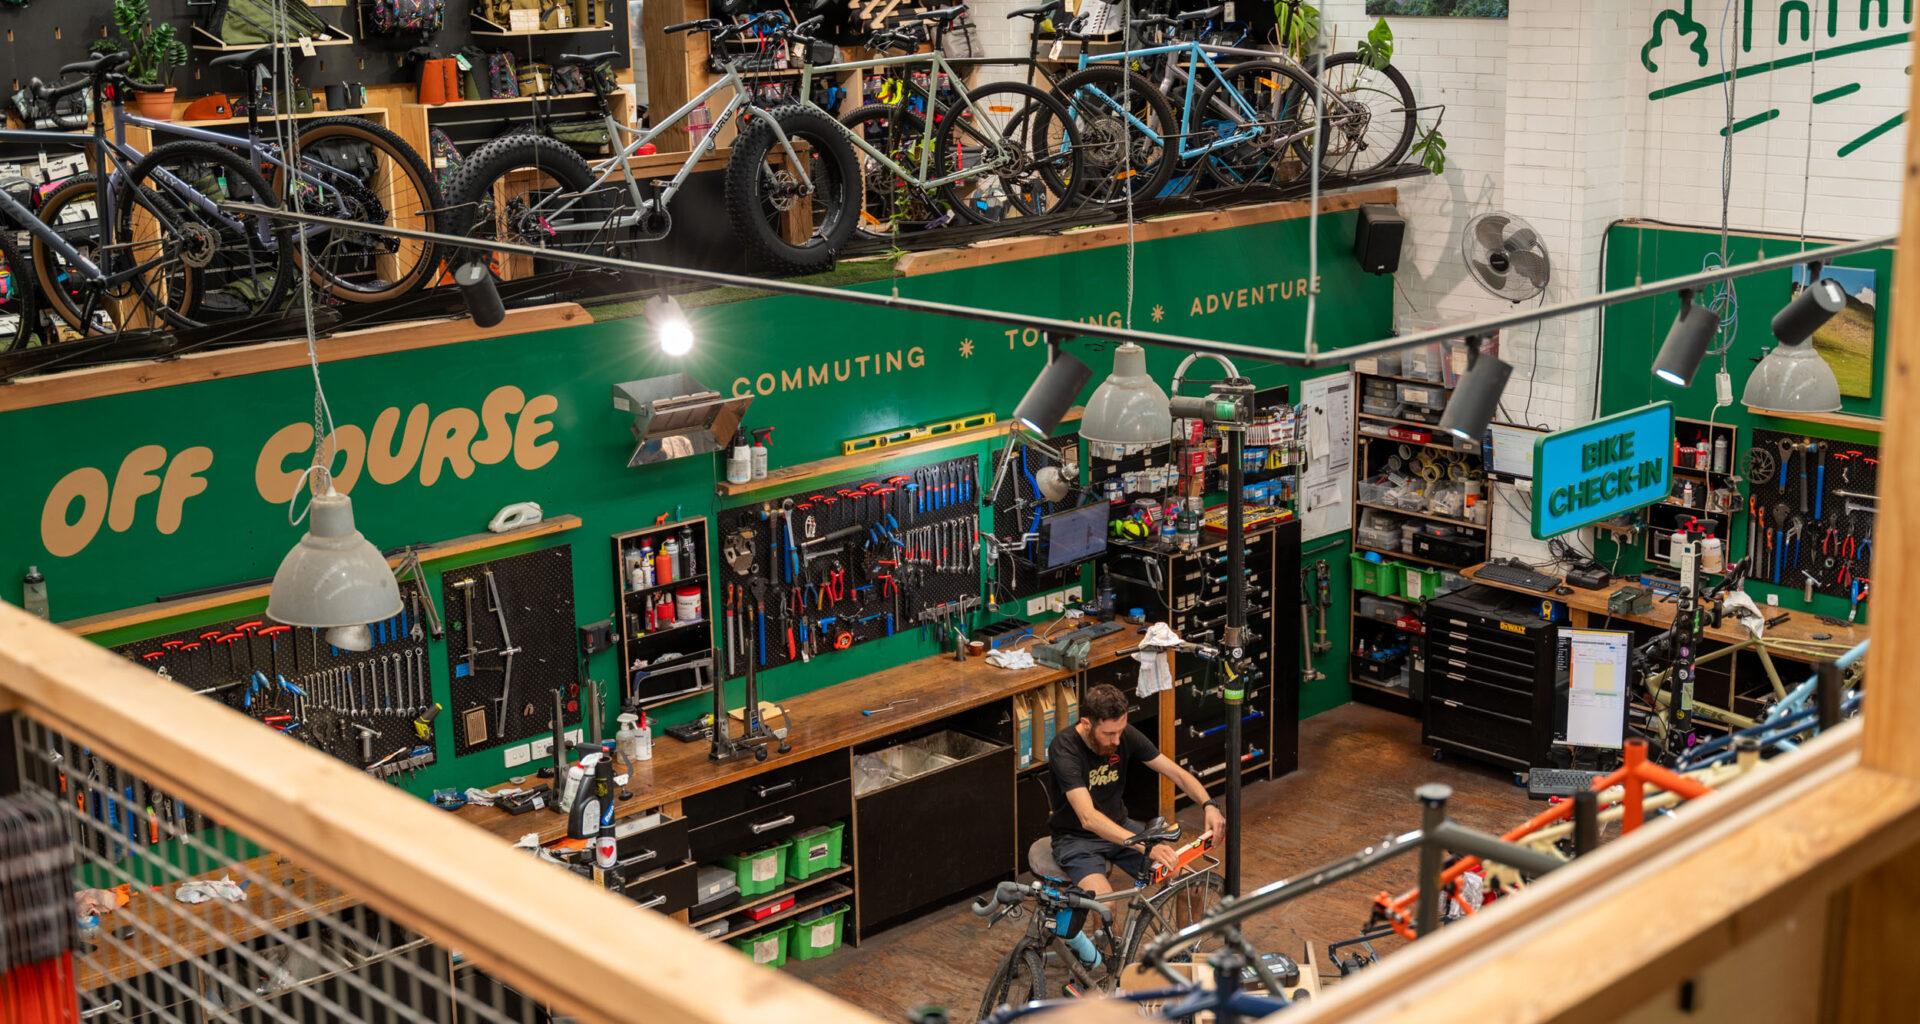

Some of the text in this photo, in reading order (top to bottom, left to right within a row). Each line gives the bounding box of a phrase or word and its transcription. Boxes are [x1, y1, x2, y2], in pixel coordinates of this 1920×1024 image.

[708, 109, 733, 139] SURLY
[1190, 276, 1320, 317] ADVENTURE
[732, 346, 925, 398] COMMUTING
[40, 385, 560, 558] OFF COURSE
[1582, 430, 1635, 473] BIKE
[1549, 456, 1662, 517] CHECK-IN
